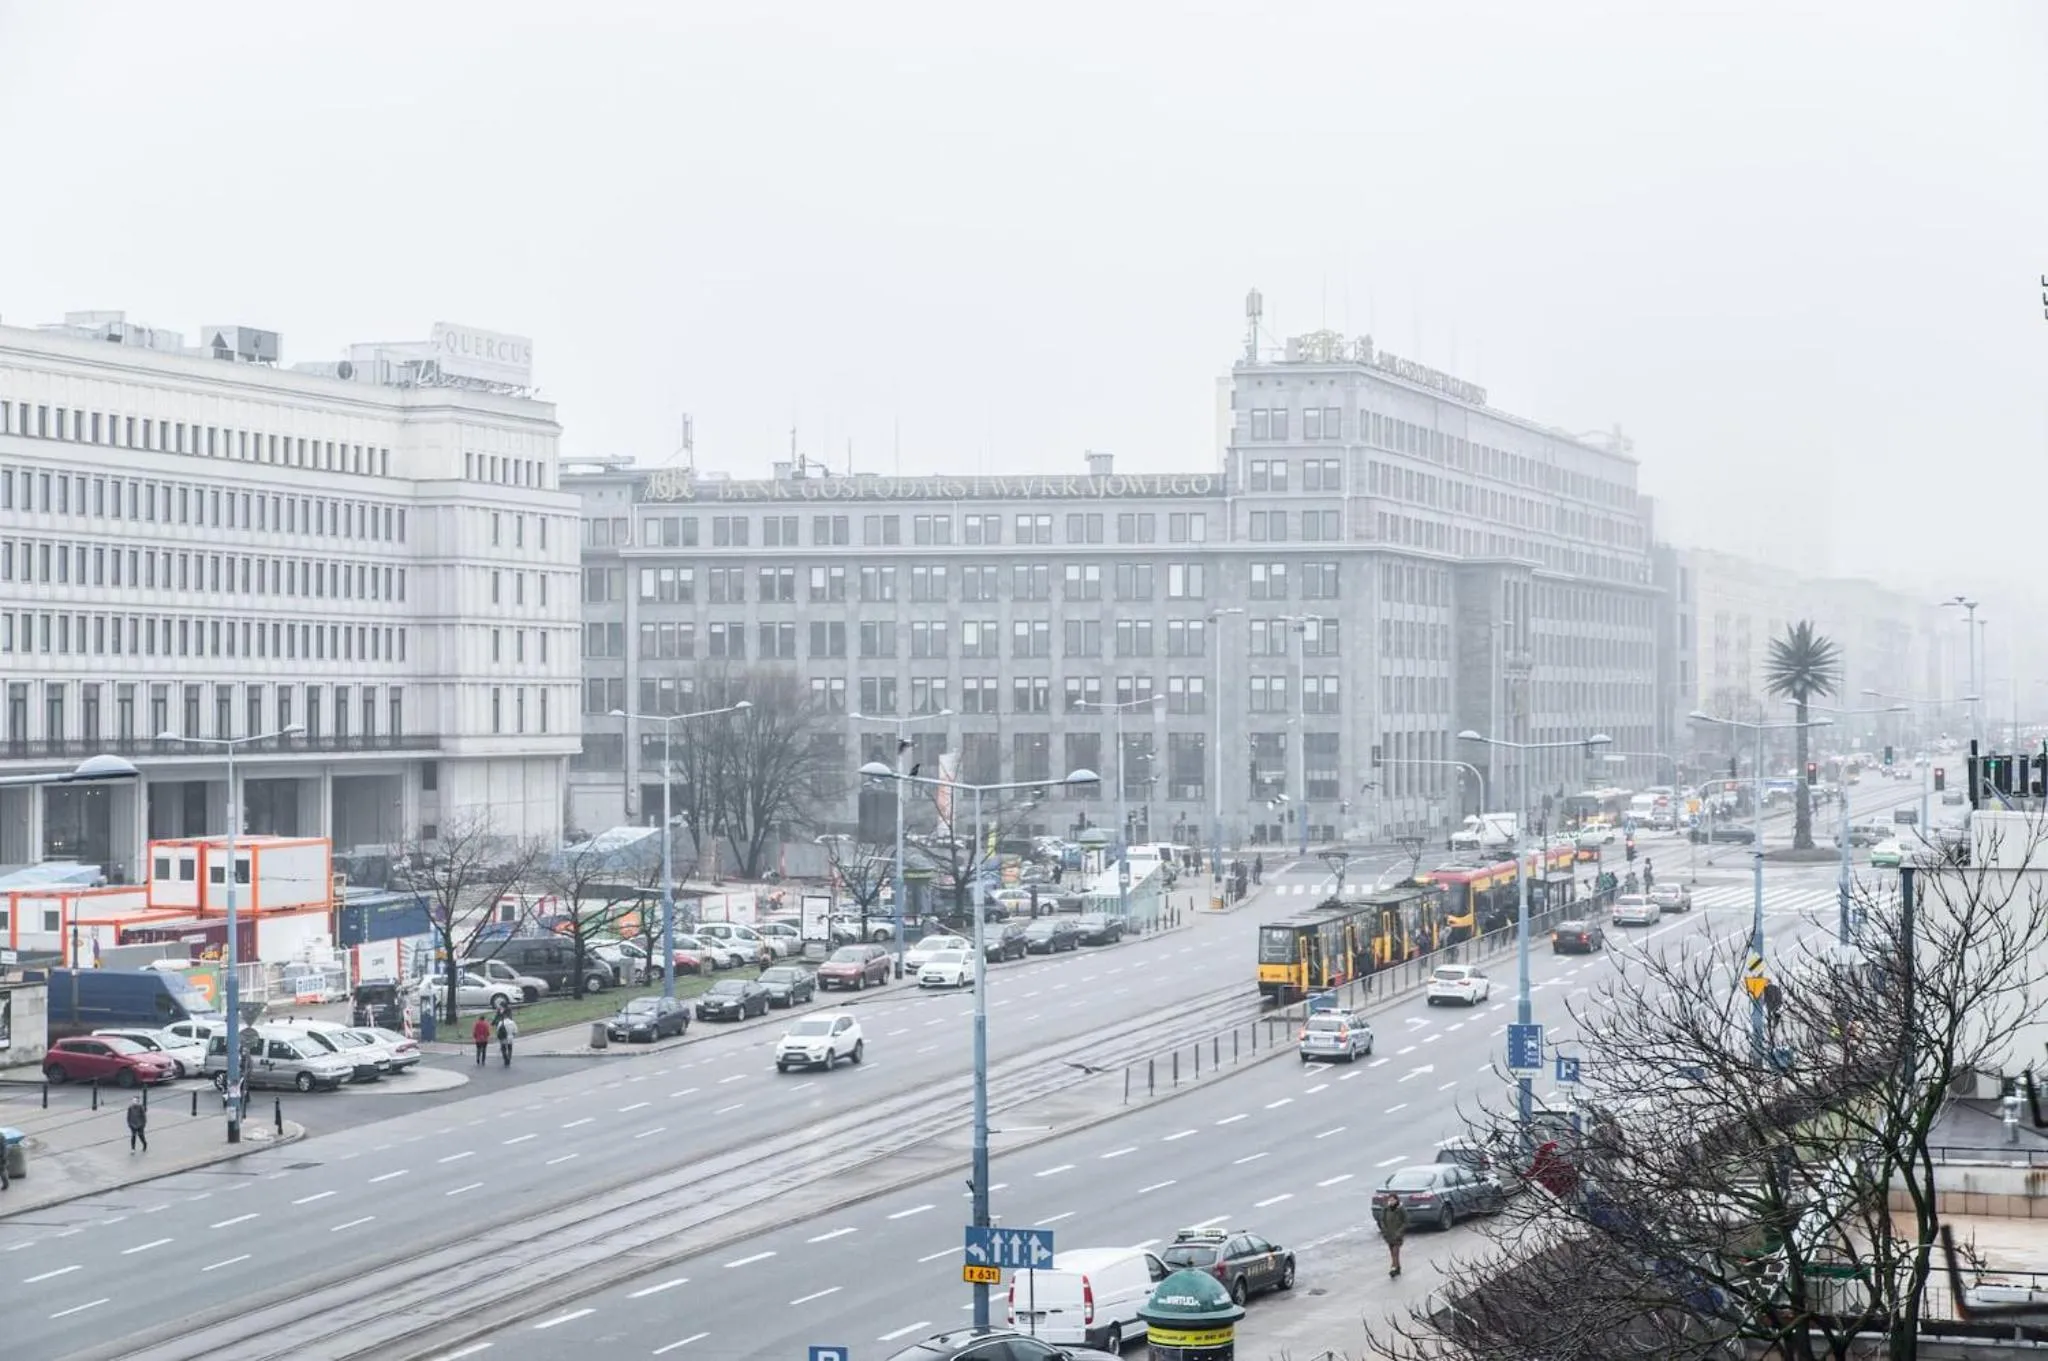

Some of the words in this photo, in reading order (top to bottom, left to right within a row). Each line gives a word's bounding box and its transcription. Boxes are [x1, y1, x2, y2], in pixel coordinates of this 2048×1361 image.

[446, 330, 532, 364] QUERCUS
[718, 479, 792, 499] BANK
[1041, 474, 1212, 497] KRAJOWEGO
[978, 1269, 997, 1280] 631
